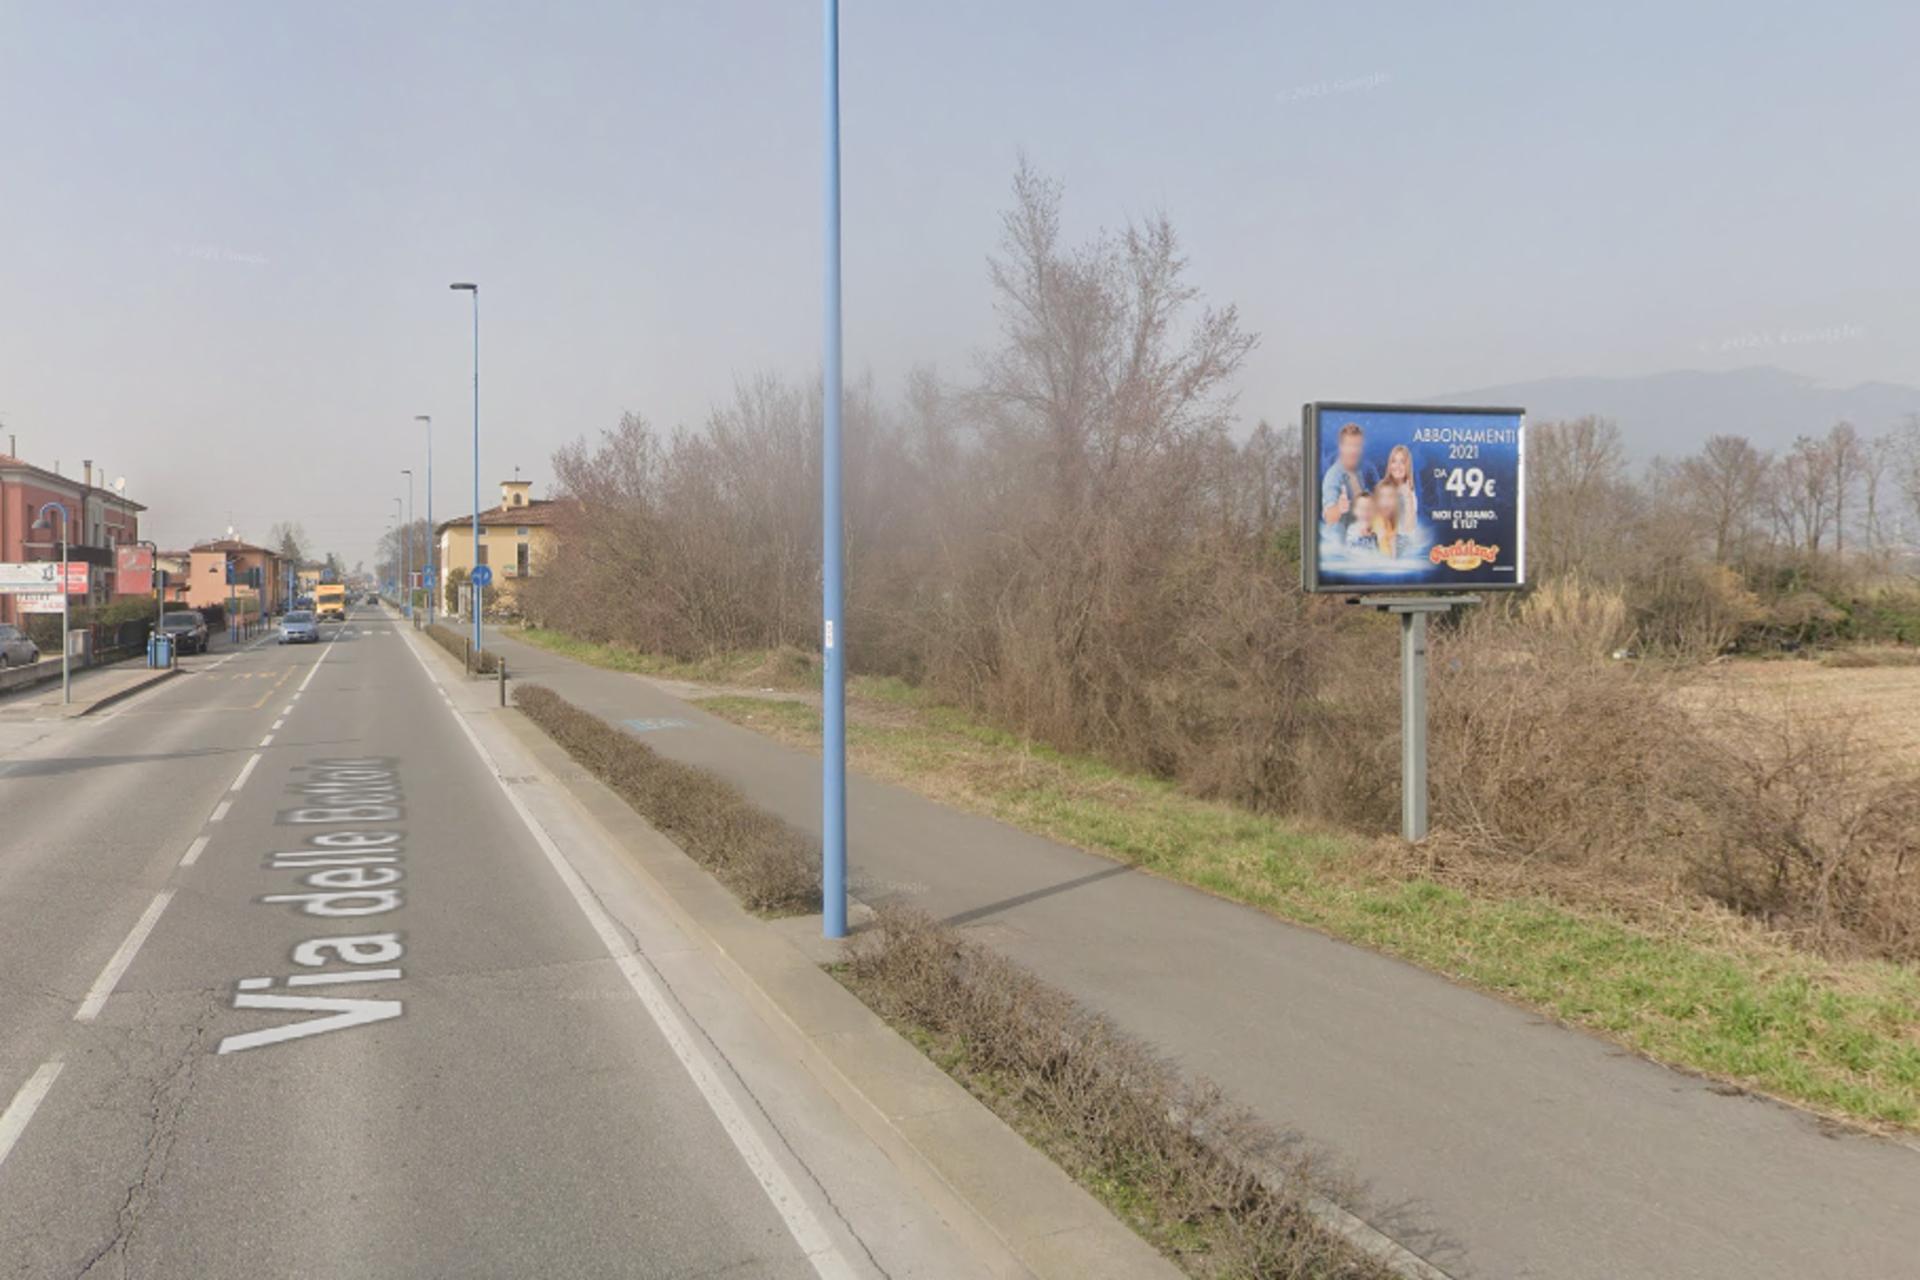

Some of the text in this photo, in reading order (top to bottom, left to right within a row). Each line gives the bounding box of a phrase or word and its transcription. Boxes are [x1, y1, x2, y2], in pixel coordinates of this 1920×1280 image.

[1413, 428, 1516, 444] ABBONAMENTI
[1448, 444, 1479, 459] 2021
[1433, 467, 1496, 497] DA 49€
